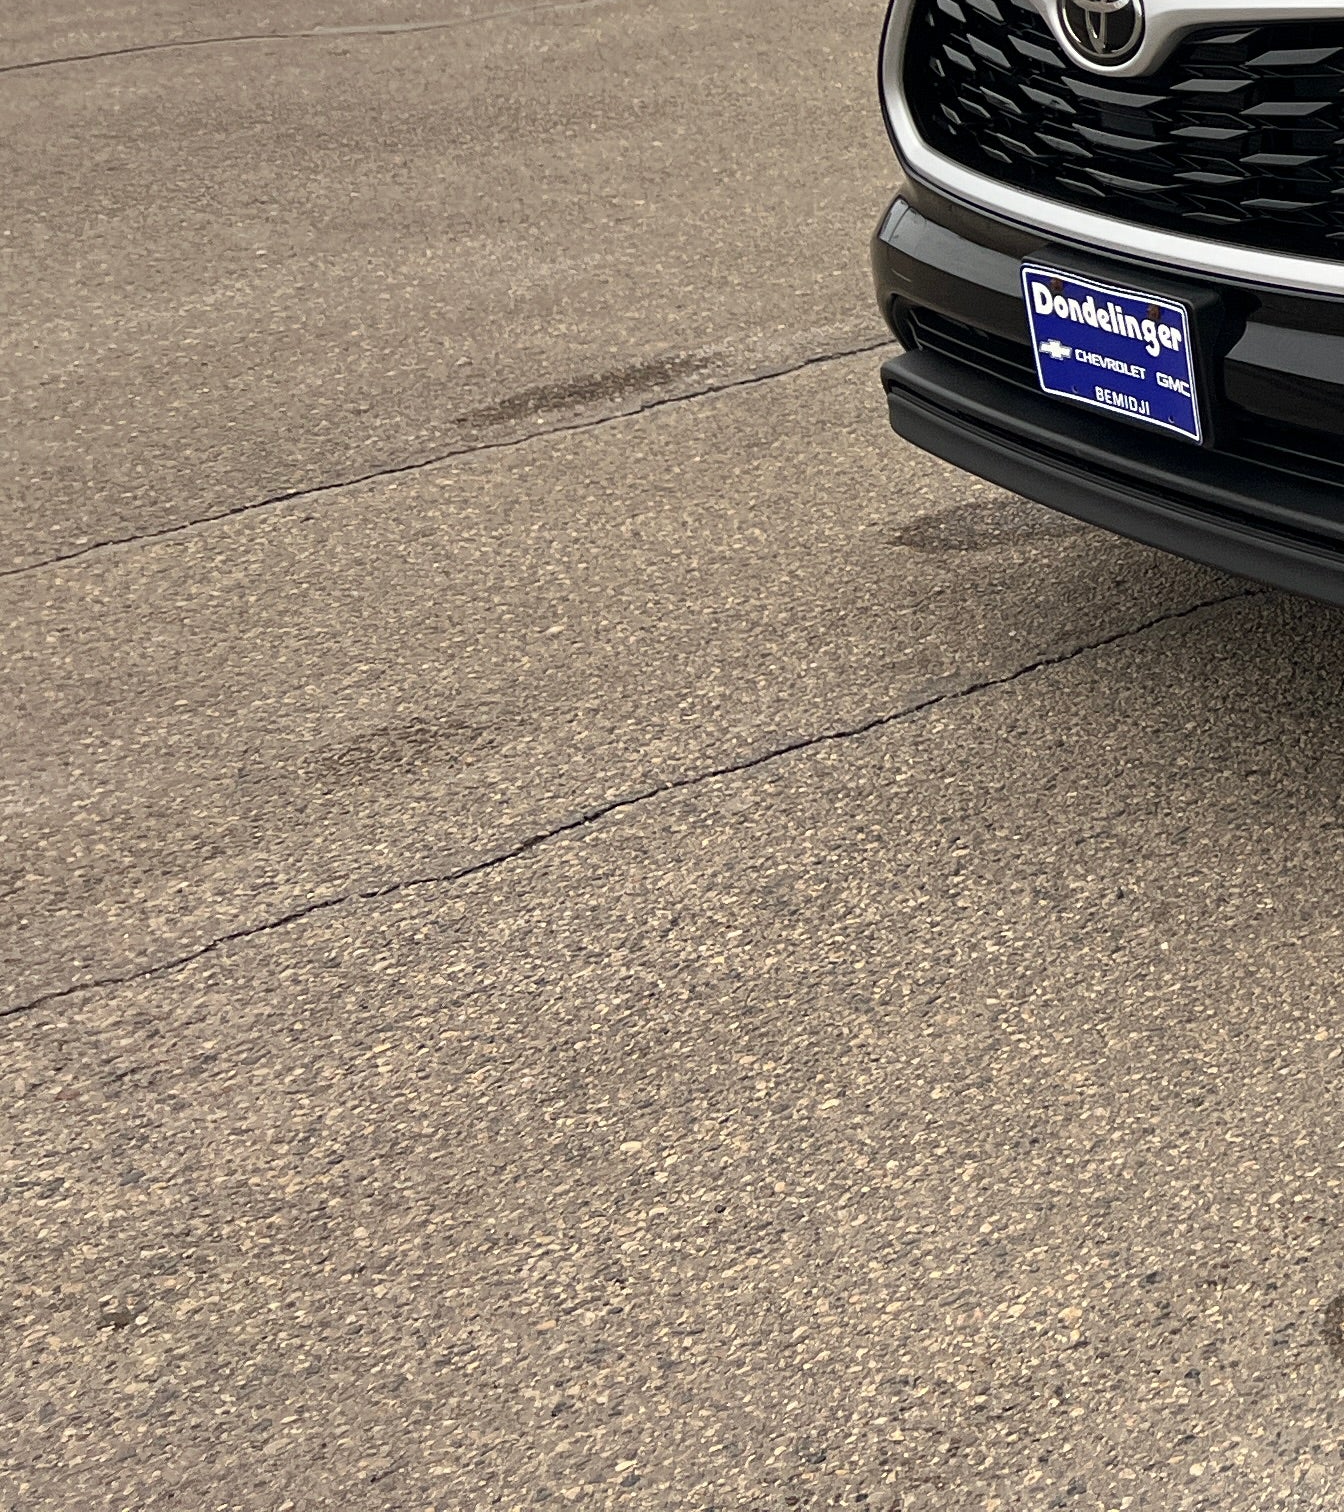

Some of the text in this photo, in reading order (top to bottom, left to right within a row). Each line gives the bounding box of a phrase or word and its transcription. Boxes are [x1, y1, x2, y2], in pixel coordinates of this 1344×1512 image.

[1031, 281, 1182, 357] Dondelinger
[1075, 348, 1191, 398] CHEVROLET GMC
[1094, 385, 1150, 416] BEMIDJI
